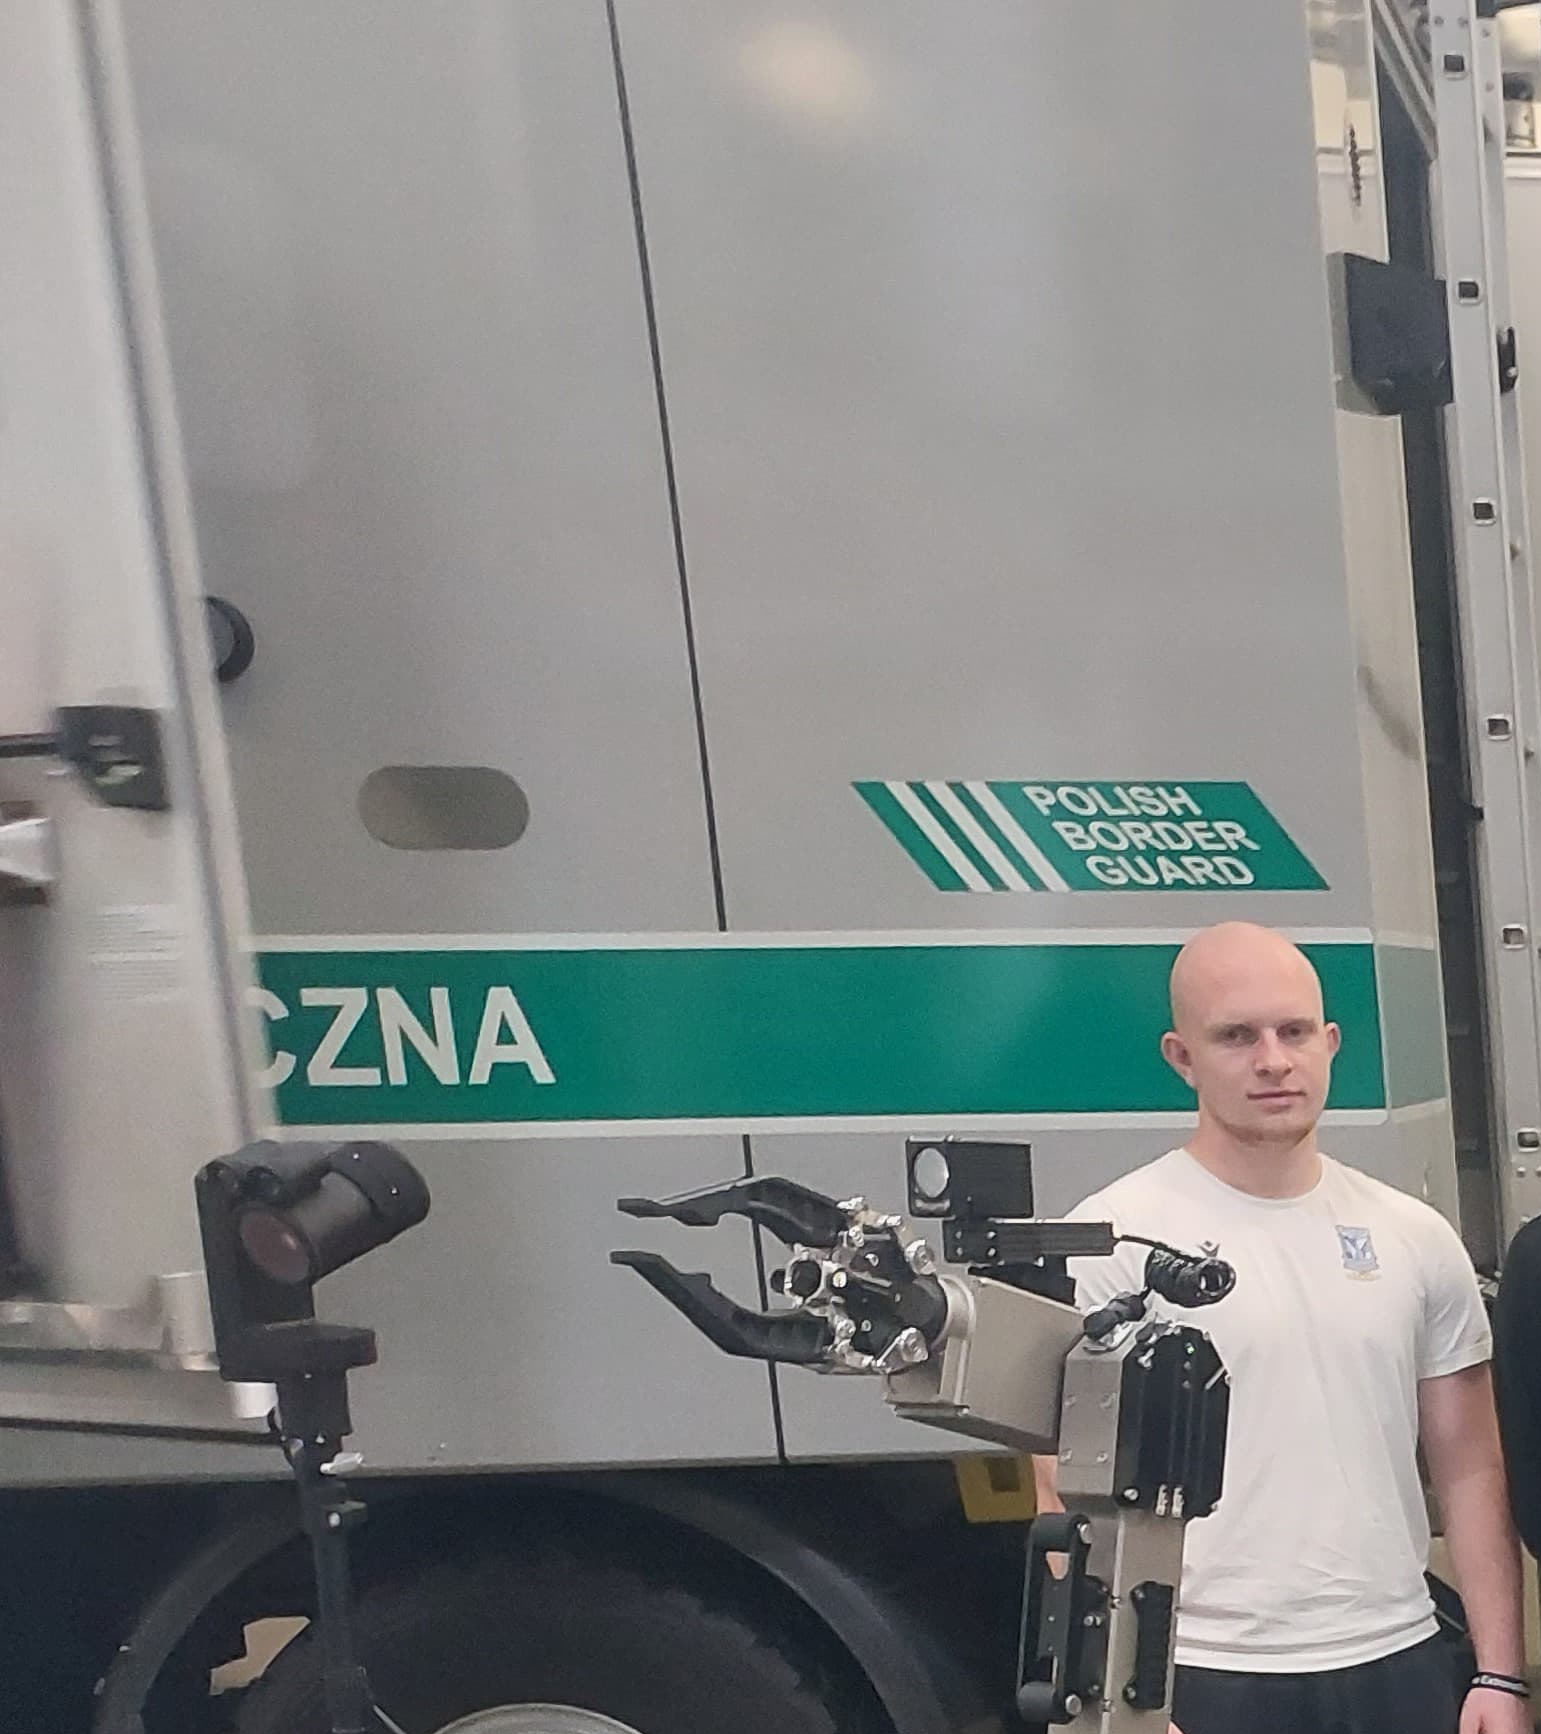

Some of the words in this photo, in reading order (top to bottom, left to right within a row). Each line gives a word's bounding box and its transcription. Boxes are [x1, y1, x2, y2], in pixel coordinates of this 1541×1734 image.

[1022, 785, 1202, 817] POLISH
[1051, 820, 1261, 851] BORDER
[1085, 855, 1255, 885] GUARD
